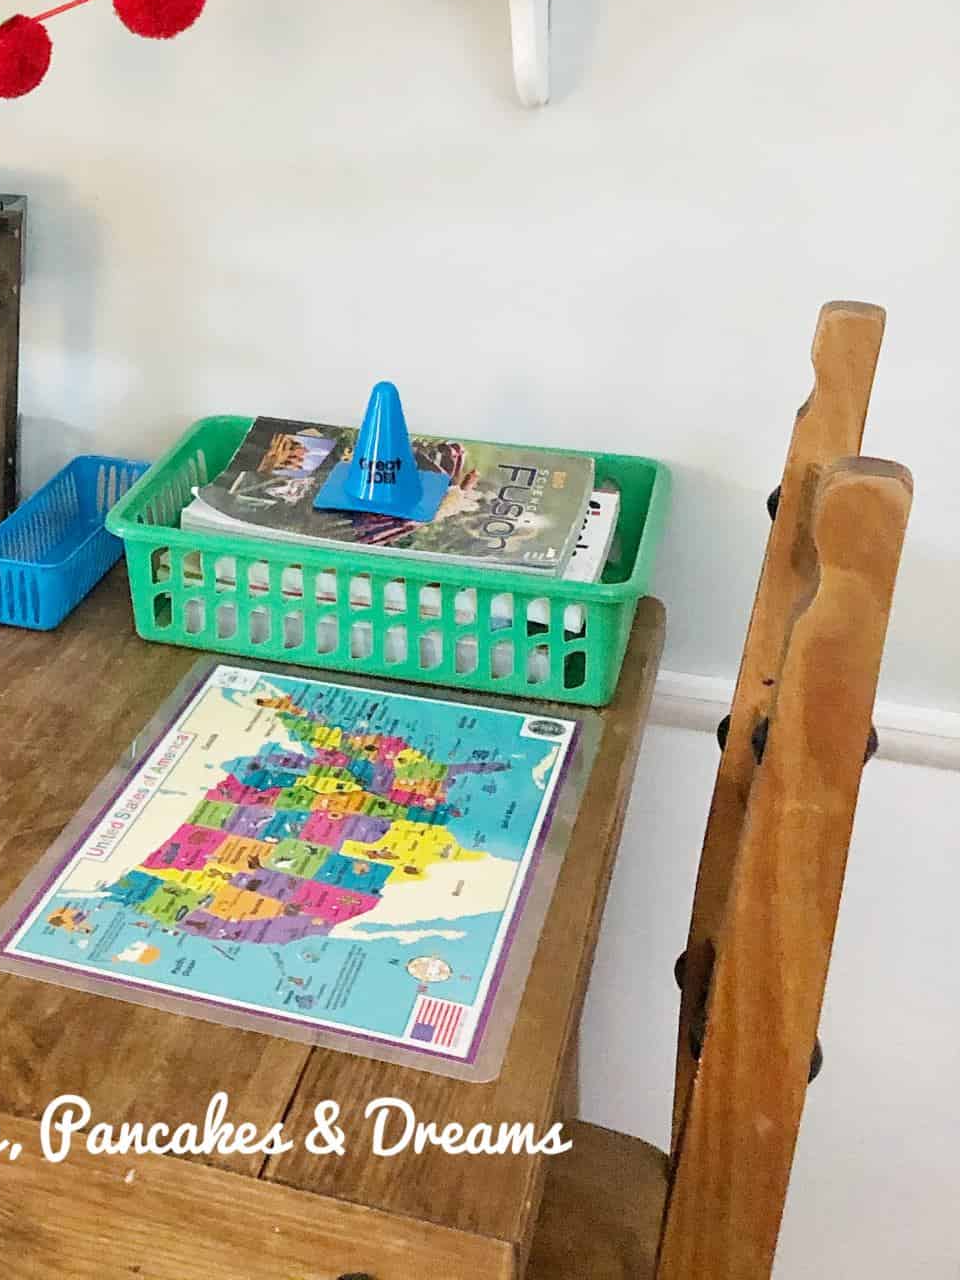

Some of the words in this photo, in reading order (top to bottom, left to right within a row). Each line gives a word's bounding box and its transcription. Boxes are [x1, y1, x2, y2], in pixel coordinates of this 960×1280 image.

[86, 820, 124, 857] United
[114, 787, 150, 821] States
[142, 774, 159, 789] of
[152, 734, 190, 775] America
